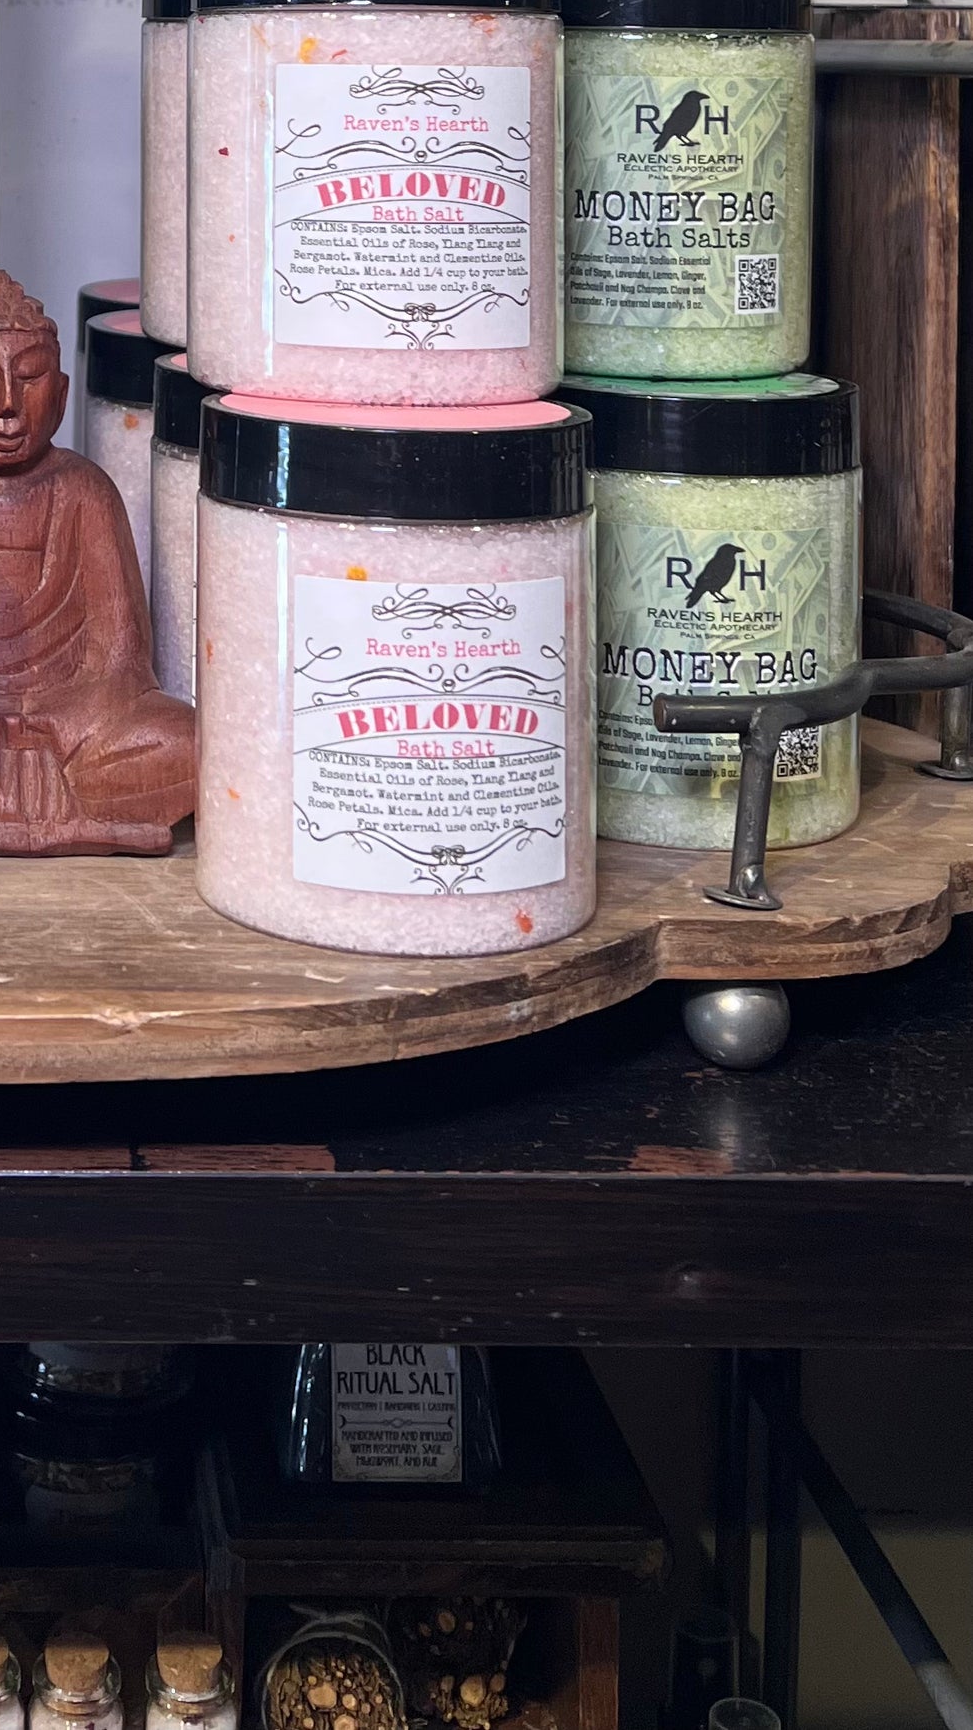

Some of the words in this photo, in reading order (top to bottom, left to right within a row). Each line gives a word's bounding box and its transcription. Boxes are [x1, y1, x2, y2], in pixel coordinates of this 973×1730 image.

[343, 115, 420, 132] Raven's
[426, 116, 489, 132] Hearth
[635, 105, 661, 134] R
[704, 105, 729, 135] H
[617, 153, 682, 164] RAVEN'S
[687, 154, 744, 165] HEARTH
[315, 172, 506, 208] BELOVED
[372, 205, 418, 221] Bath
[423, 206, 464, 222] Salt
[574, 189, 705, 223] MONEY
[719, 192, 776, 222] BAG
[290, 222, 348, 233] CONTAINS:
[352, 224, 387, 235] Epsom
[390, 224, 420, 234] Salt.
[424, 224, 465, 235] Sodium
[607, 225, 672, 248] Bath
[681, 228, 751, 249] Salts
[300, 236, 359, 247] Essential
[362, 238, 389, 249] Oils
[392, 238, 407, 249] of
[441, 239, 474, 250] Ylang
[476, 239, 503, 250] Ylang
[506, 239, 521, 248] and
[293, 249, 351, 262] Bergamot.
[419, 253, 441, 263] and
[289, 263, 315, 275] Rose
[318, 265, 360, 276] Petals.
[364, 266, 396, 276] Mica.
[400, 267, 420, 277] Add
[423, 267, 444, 277] 1/4
[446, 269, 466, 279] cup
[469, 268, 480, 277] to
[482, 268, 505, 279] your
[335, 280, 356, 290] For
[359, 280, 416, 291] external
[419, 283, 437, 292] use
[440, 281, 470, 294] only.
[471, 281, 478, 291] 8
[666, 556, 693, 589] R
[739, 559, 766, 591] H
[647, 608, 715, 621] RAVEN'S
[721, 611, 782, 622] HEARTH
[366, 638, 447, 658] Raven's
[454, 639, 521, 658] Hearth
[603, 642, 741, 684] MONEY
[755, 648, 818, 684] BAG
[336, 702, 539, 739] BELOVED
[397, 740, 445, 757] Bath
[452, 739, 495, 758] Salt
[367, 1344, 425, 1366] BLACK
[337, 1372, 403, 1394] RITUAL
[409, 1372, 455, 1394] SALT
